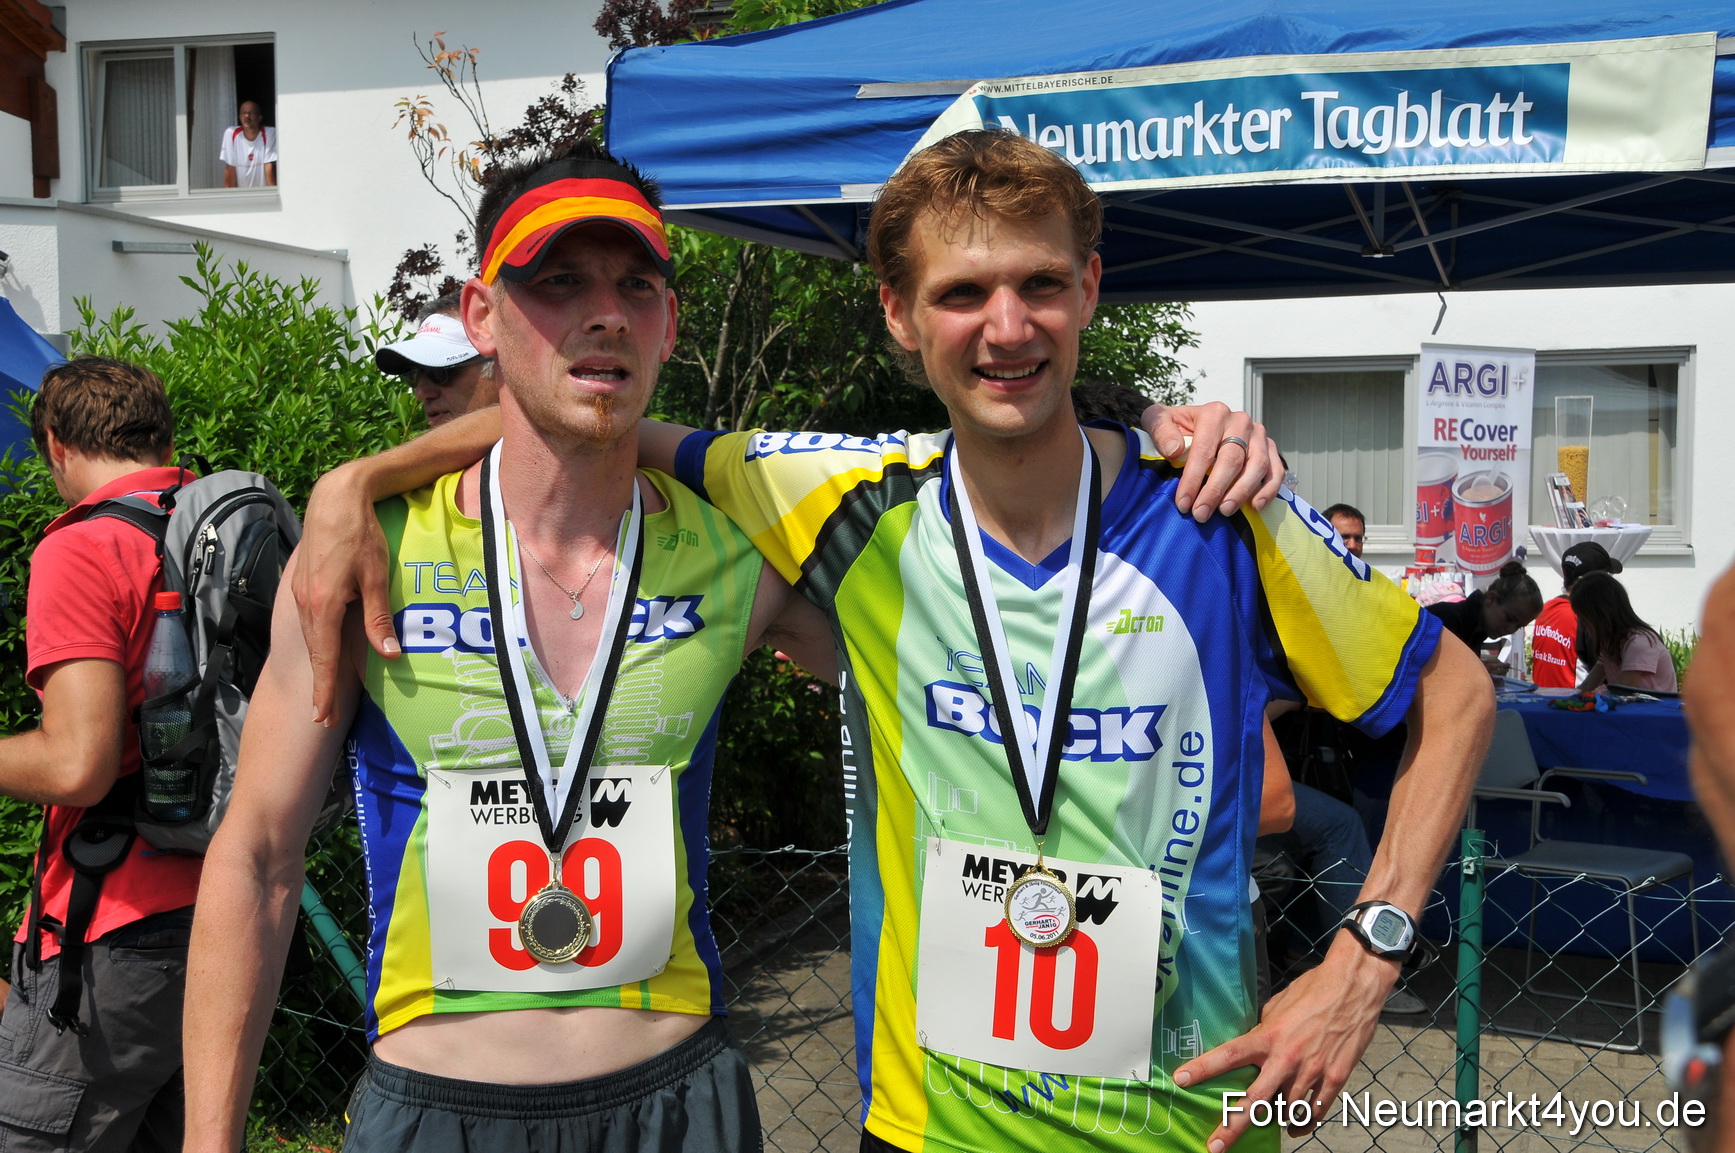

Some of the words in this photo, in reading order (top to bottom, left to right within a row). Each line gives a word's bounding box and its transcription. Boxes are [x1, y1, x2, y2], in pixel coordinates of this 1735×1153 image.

[978, 76, 1114, 93] WWW.MITTELBAYERISCHE.DE
[997, 100, 1292, 165] Neumarkter
[1301, 89, 1534, 154] Tagblatt
[1460, 444, 1517, 461] Yourself
[487, 837, 622, 971] 99
[983, 917, 1099, 1051] 10
